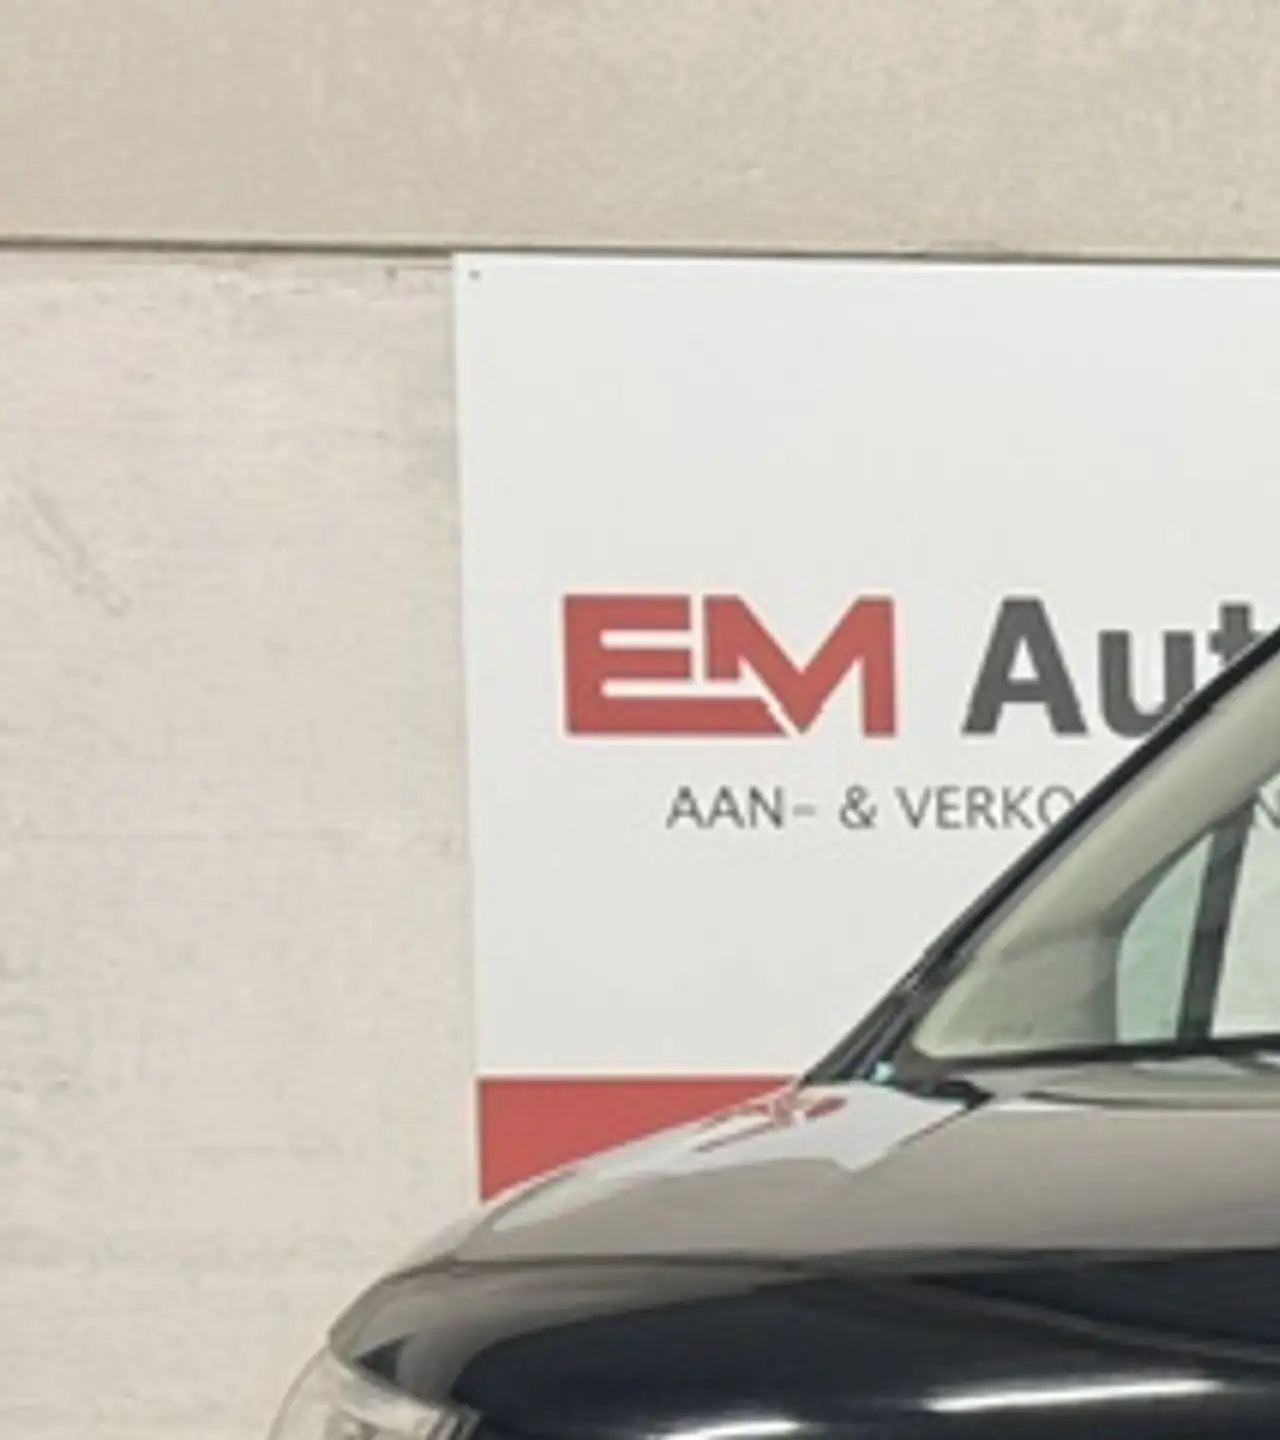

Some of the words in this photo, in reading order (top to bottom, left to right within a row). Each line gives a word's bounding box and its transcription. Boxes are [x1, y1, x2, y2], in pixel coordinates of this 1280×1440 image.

[563, 593, 898, 739] EM
[665, 784, 817, 831] AAN-
[838, 784, 878, 831] &
